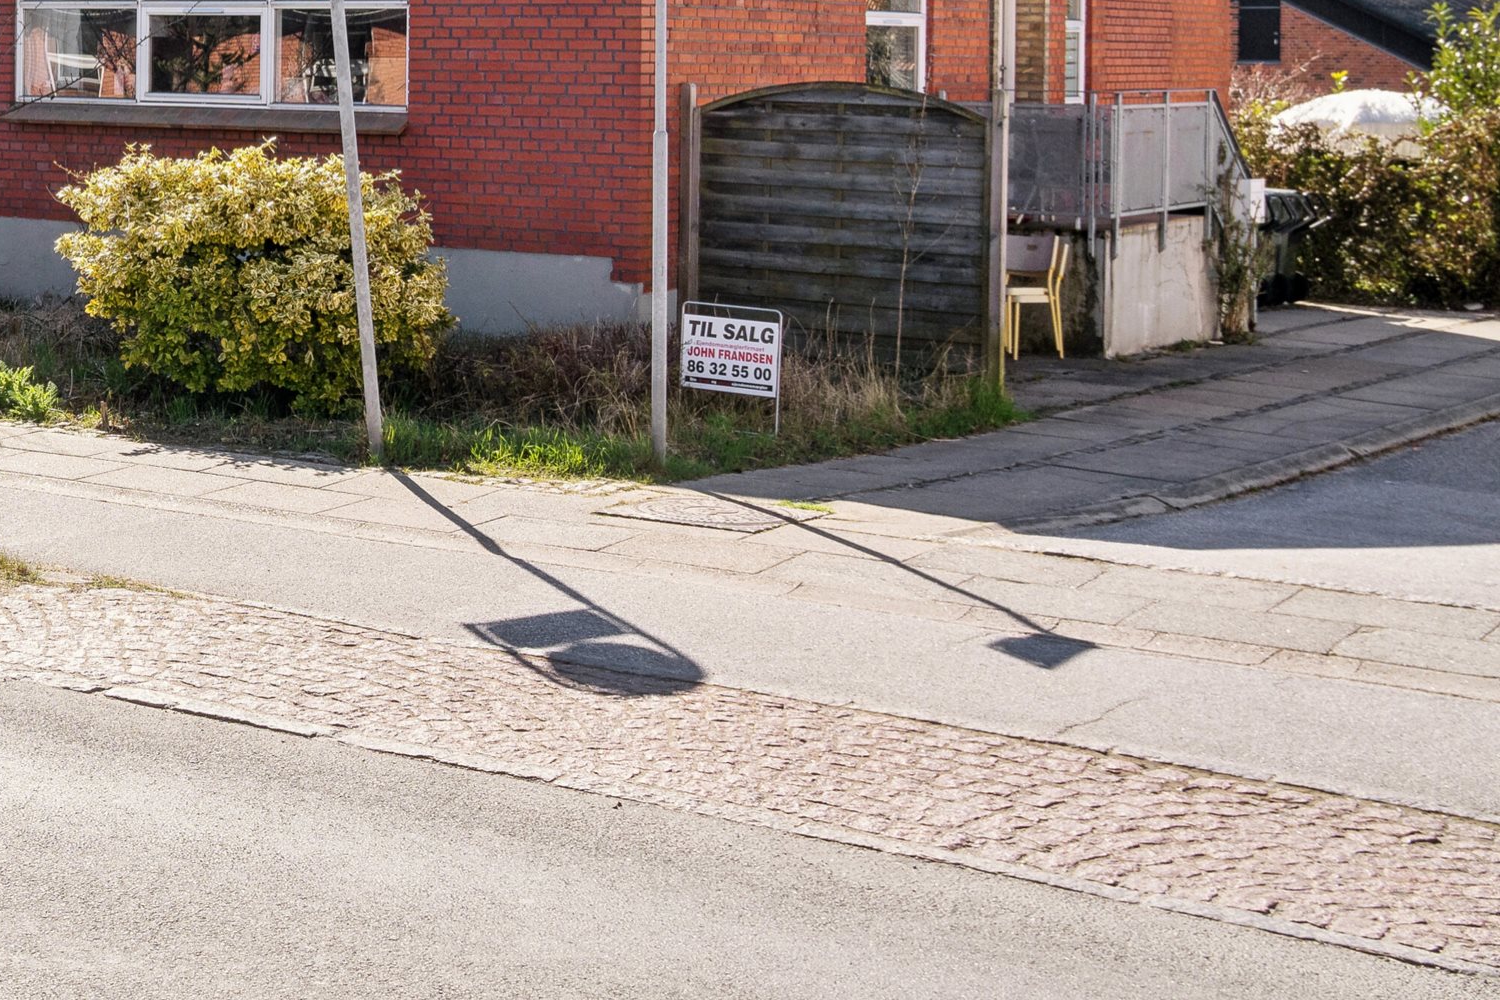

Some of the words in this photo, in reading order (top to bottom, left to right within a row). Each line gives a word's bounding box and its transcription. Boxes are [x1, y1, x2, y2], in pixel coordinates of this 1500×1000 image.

[689, 320, 717, 338] TIL
[722, 323, 775, 344] SALG
[687, 346, 716, 358] JOHN
[718, 349, 773, 365] FRANDSEN
[687, 360, 705, 374] 86
[709, 362, 727, 376] 32
[731, 364, 749, 379] 55
[753, 367, 772, 381] 00
